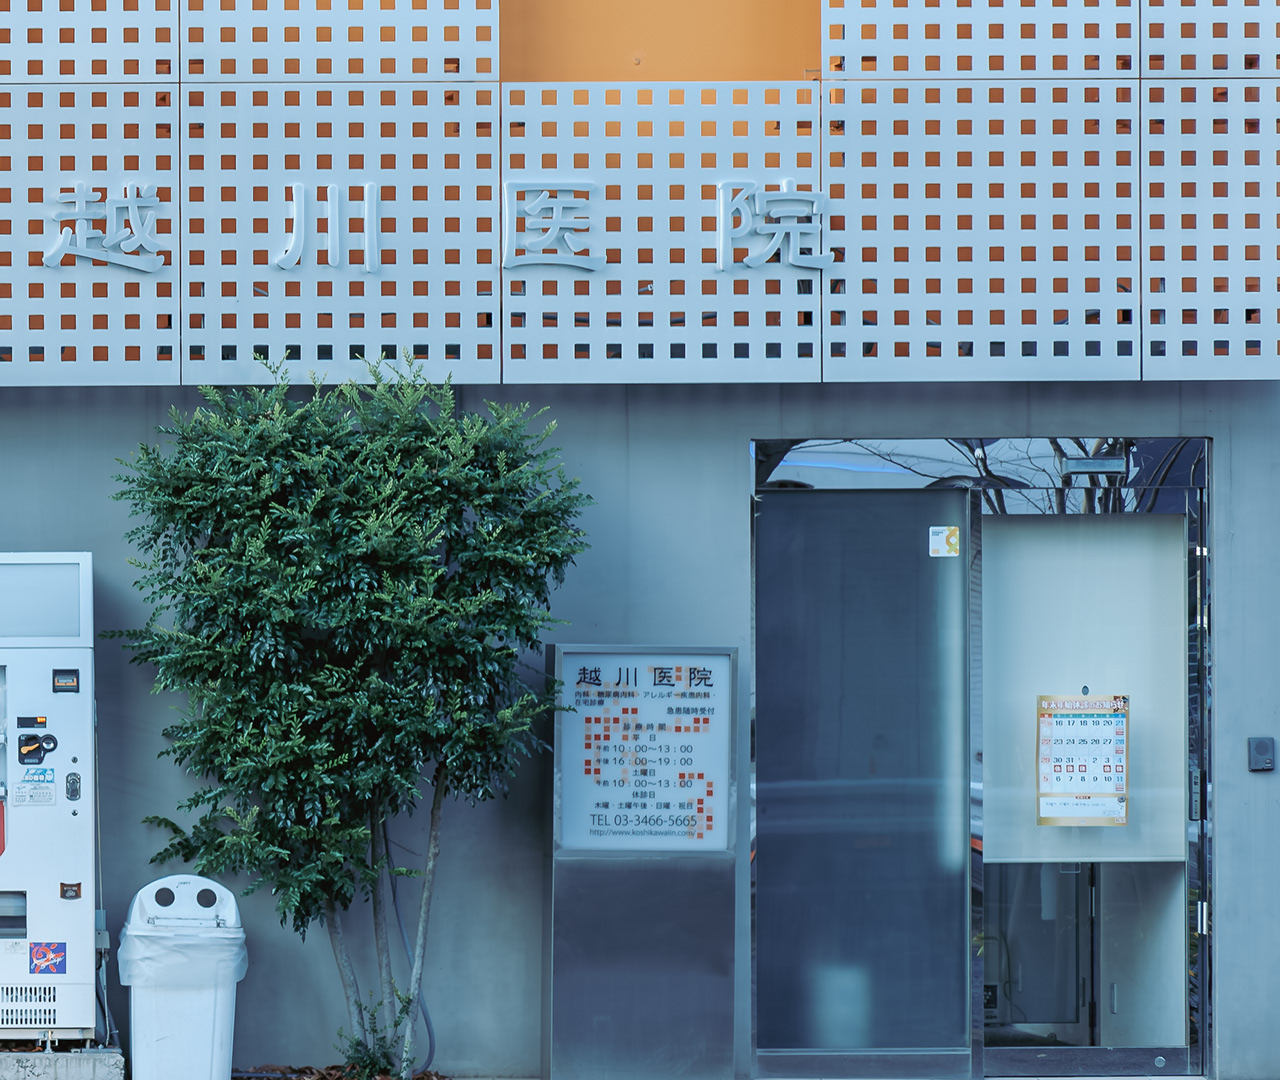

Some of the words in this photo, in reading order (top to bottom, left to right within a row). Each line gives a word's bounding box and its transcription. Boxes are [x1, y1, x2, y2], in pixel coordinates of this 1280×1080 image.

[42, 179, 834, 273] 越川医院
[576, 666, 714, 687] 越川医院
[666, 707, 715, 715] 急患随時受付
[623, 723, 667, 732] 診療時間
[596, 745, 609, 753] 午前
[632, 769, 656, 777] 土曜日
[632, 791, 656, 799] 休診日
[590, 814, 610, 827] TEL
[614, 814, 698, 827] 03-3466-5665
[589, 829, 696, 837] http://www.koshikawaiin.com/
